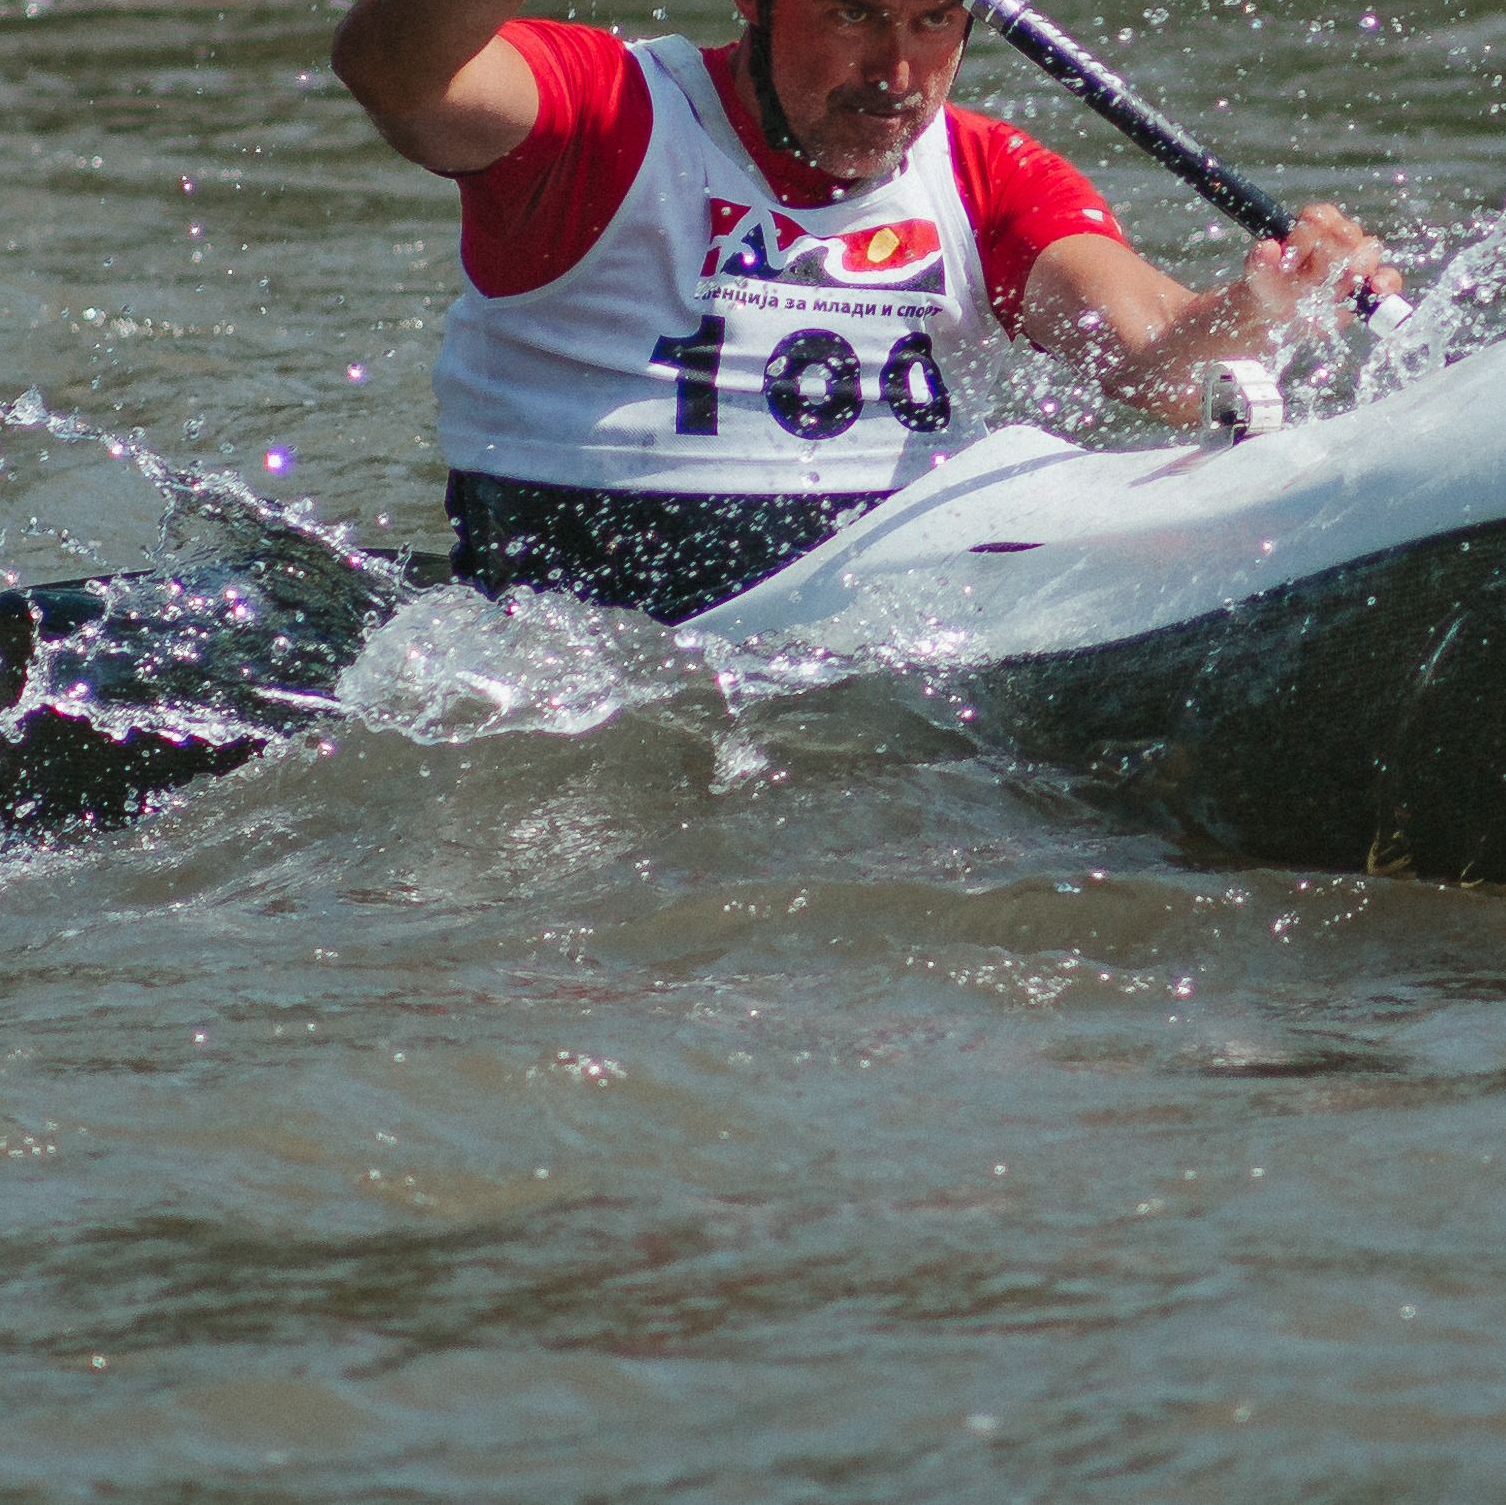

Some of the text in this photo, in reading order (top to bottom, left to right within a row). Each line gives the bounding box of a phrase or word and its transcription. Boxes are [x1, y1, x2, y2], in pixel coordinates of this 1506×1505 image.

[784, 297, 807, 311] за
[812, 298, 877, 318] млади
[881, 303, 893, 316] и
